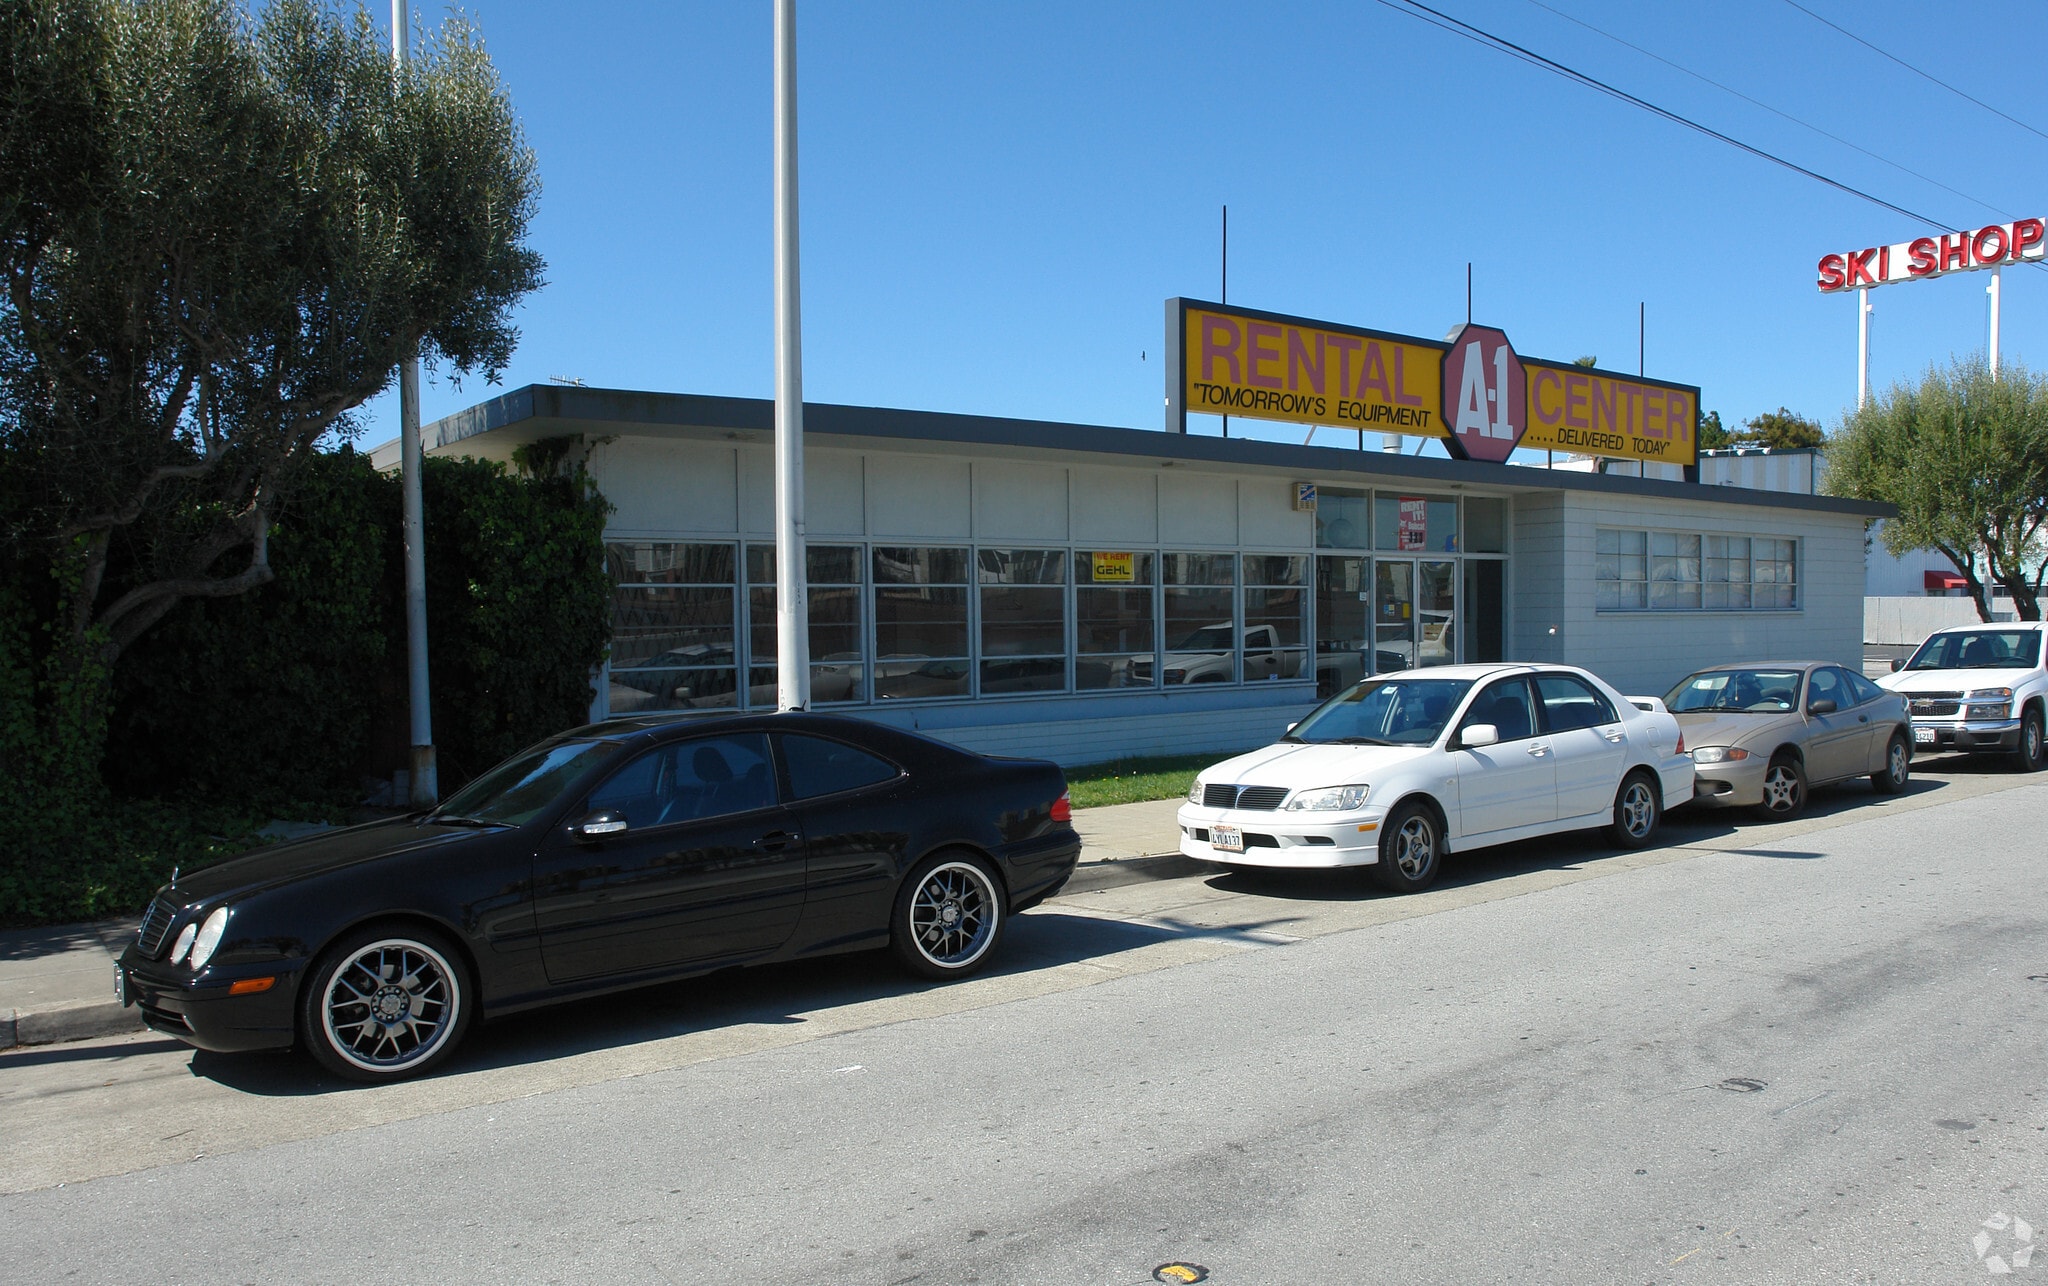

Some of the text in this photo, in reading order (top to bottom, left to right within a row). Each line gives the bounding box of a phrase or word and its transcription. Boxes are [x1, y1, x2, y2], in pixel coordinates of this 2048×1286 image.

[1817, 217, 2045, 291] SKI SHOP
[1201, 315, 1423, 407] RENTAL
[1455, 340, 1514, 441] A-1
[1337, 400, 1432, 428] EQUIPMENT
[1532, 369, 1689, 442] CENTER
[1096, 565, 1130, 575] GEHL
